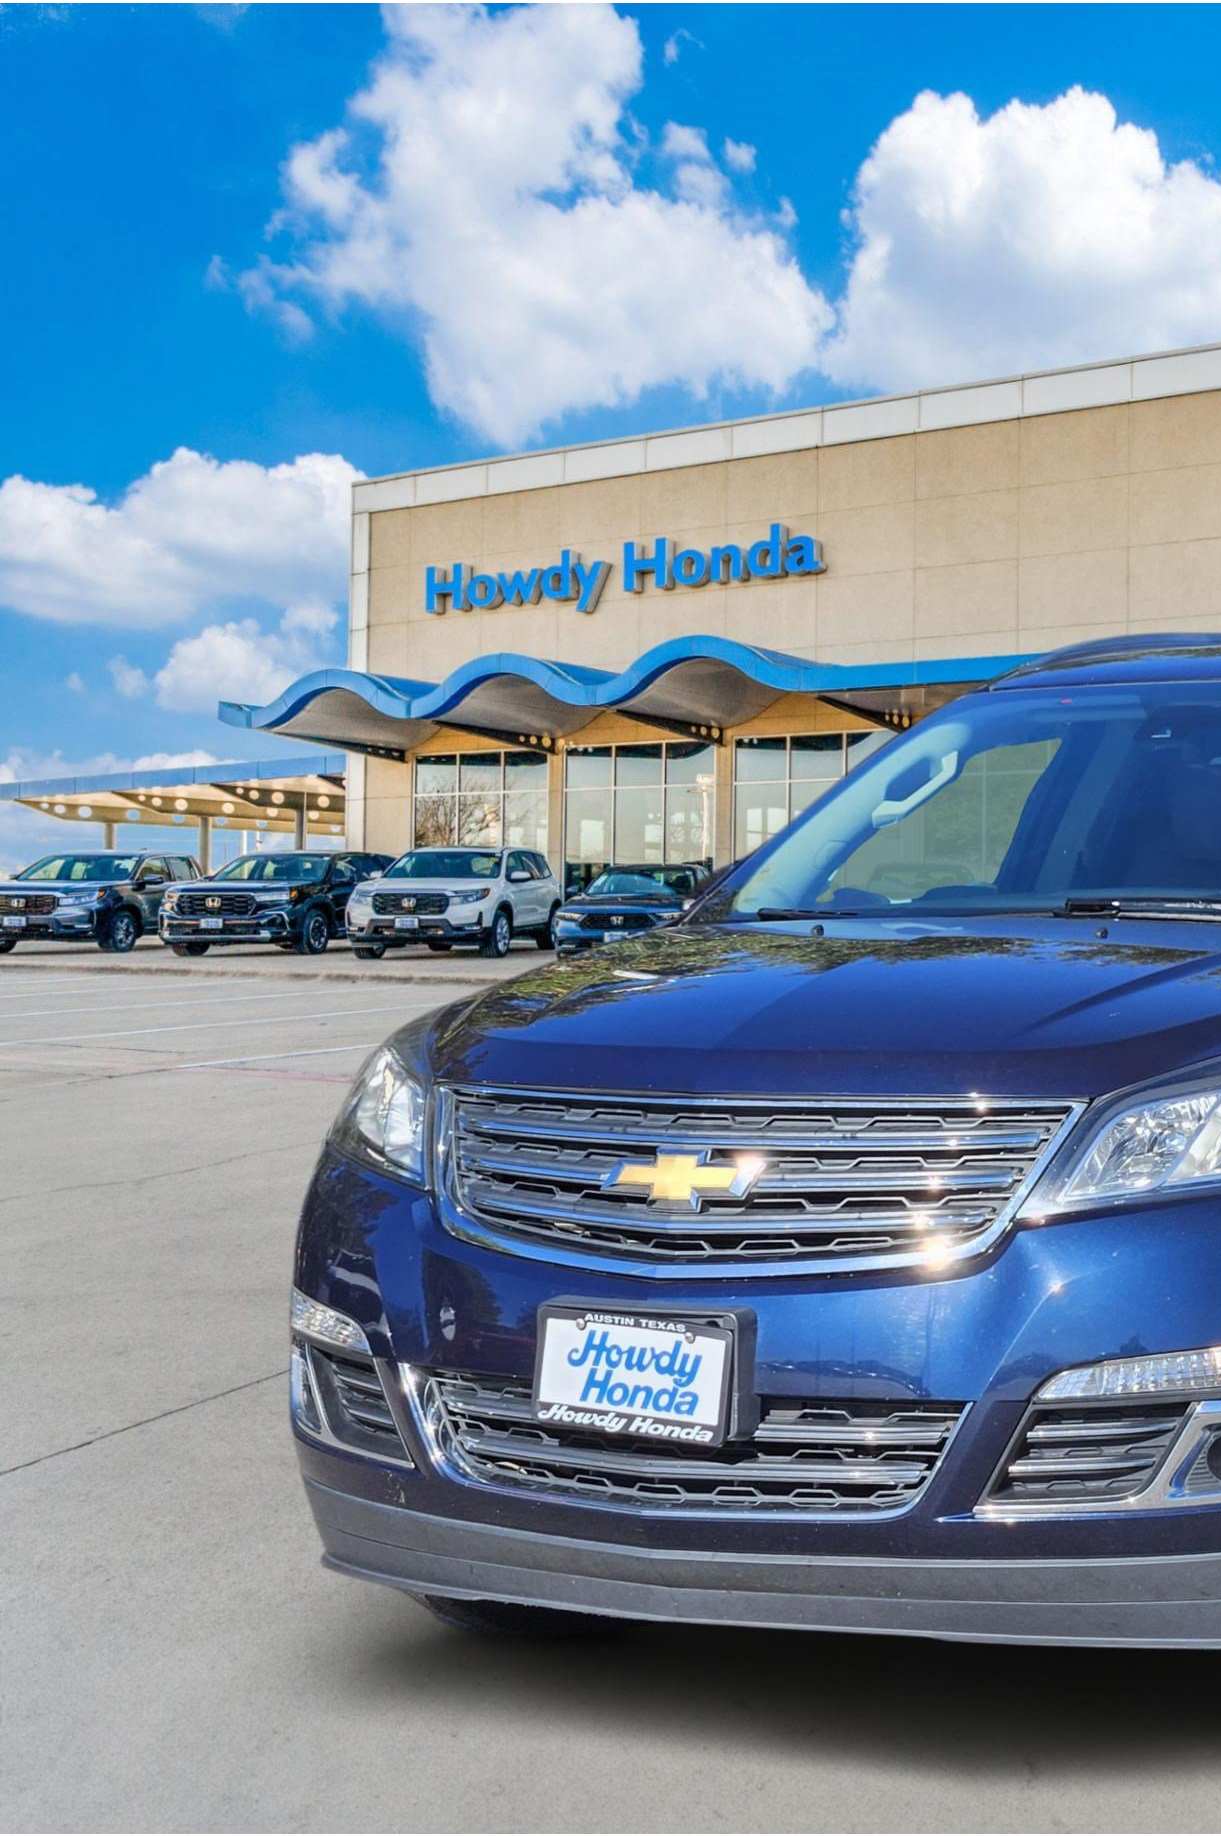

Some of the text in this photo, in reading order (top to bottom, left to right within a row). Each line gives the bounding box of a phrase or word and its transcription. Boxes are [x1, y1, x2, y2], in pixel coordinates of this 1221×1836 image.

[425, 523, 828, 615] Howdy Honda
[584, 1313, 687, 1333] AUSTIN TEXAS
[567, 1329, 703, 1388] Howdy
[579, 1367, 699, 1415] Honda
[538, 1402, 714, 1443] Howdy Honda
